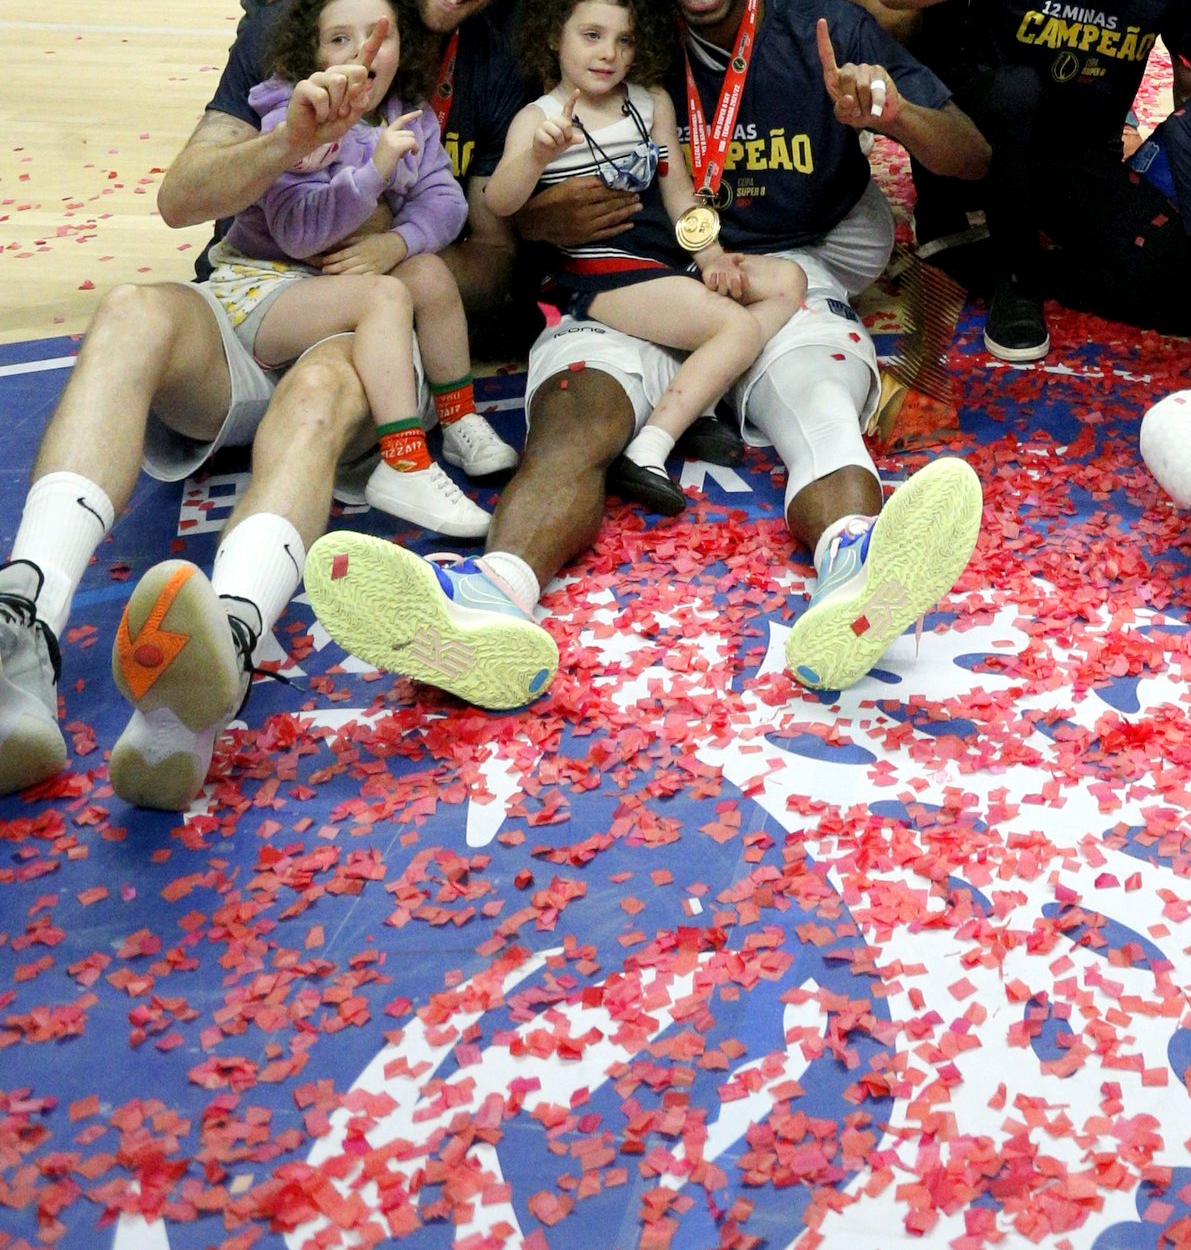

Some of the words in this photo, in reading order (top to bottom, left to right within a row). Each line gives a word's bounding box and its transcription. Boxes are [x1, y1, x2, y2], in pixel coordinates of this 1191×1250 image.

[1042, 1, 1061, 17] 12
[1062, 5, 1118, 29] MINAS
[1016, 10, 1155, 61] CAMPEÃO
[682, 129, 813, 174] PEÃO
[736, 186, 759, 196] SUPER
[737, 177, 754, 187] COPA
